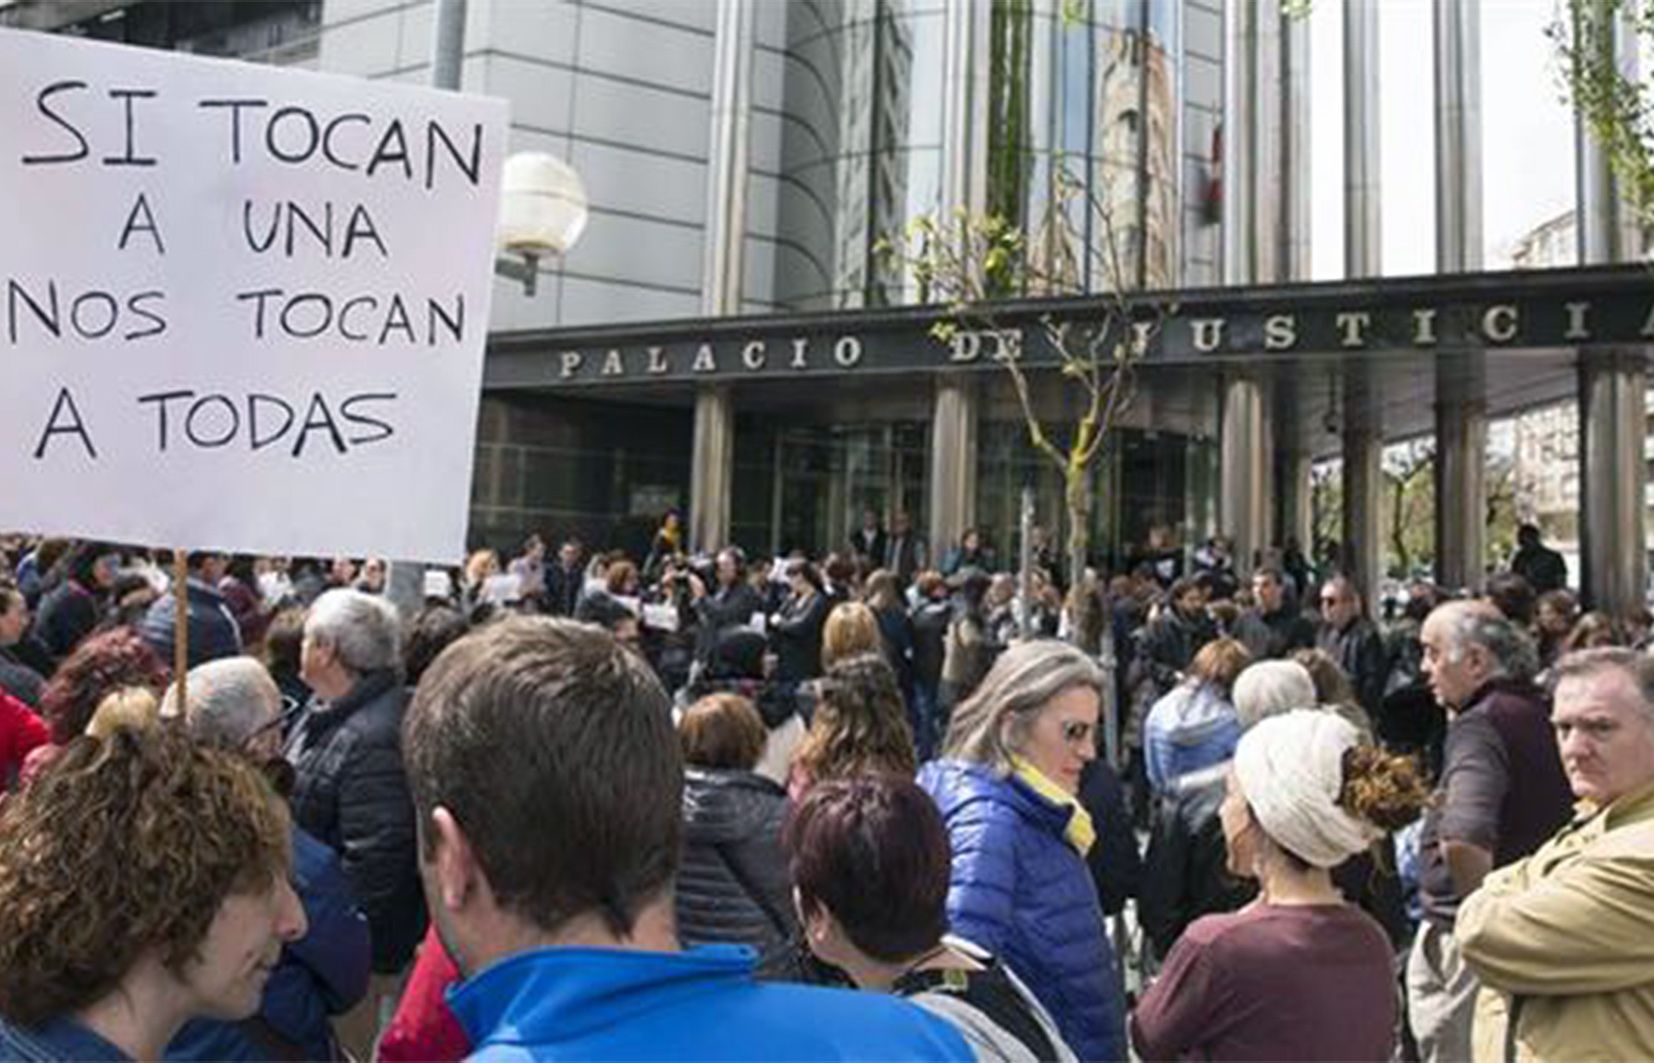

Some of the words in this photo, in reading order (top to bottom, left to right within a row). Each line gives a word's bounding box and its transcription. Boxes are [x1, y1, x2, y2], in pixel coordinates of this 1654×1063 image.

[22, 81, 157, 166] SI
[199, 100, 482, 189] TOCAN
[118, 193, 165, 254] A
[243, 200, 387, 258] UNA
[8, 279, 167, 343] NOS
[237, 289, 465, 346] TOCAN
[560, 336, 861, 377] PALACIO
[948, 328, 1024, 362] DE
[34, 387, 97, 459] A
[138, 390, 398, 458] TODAS
